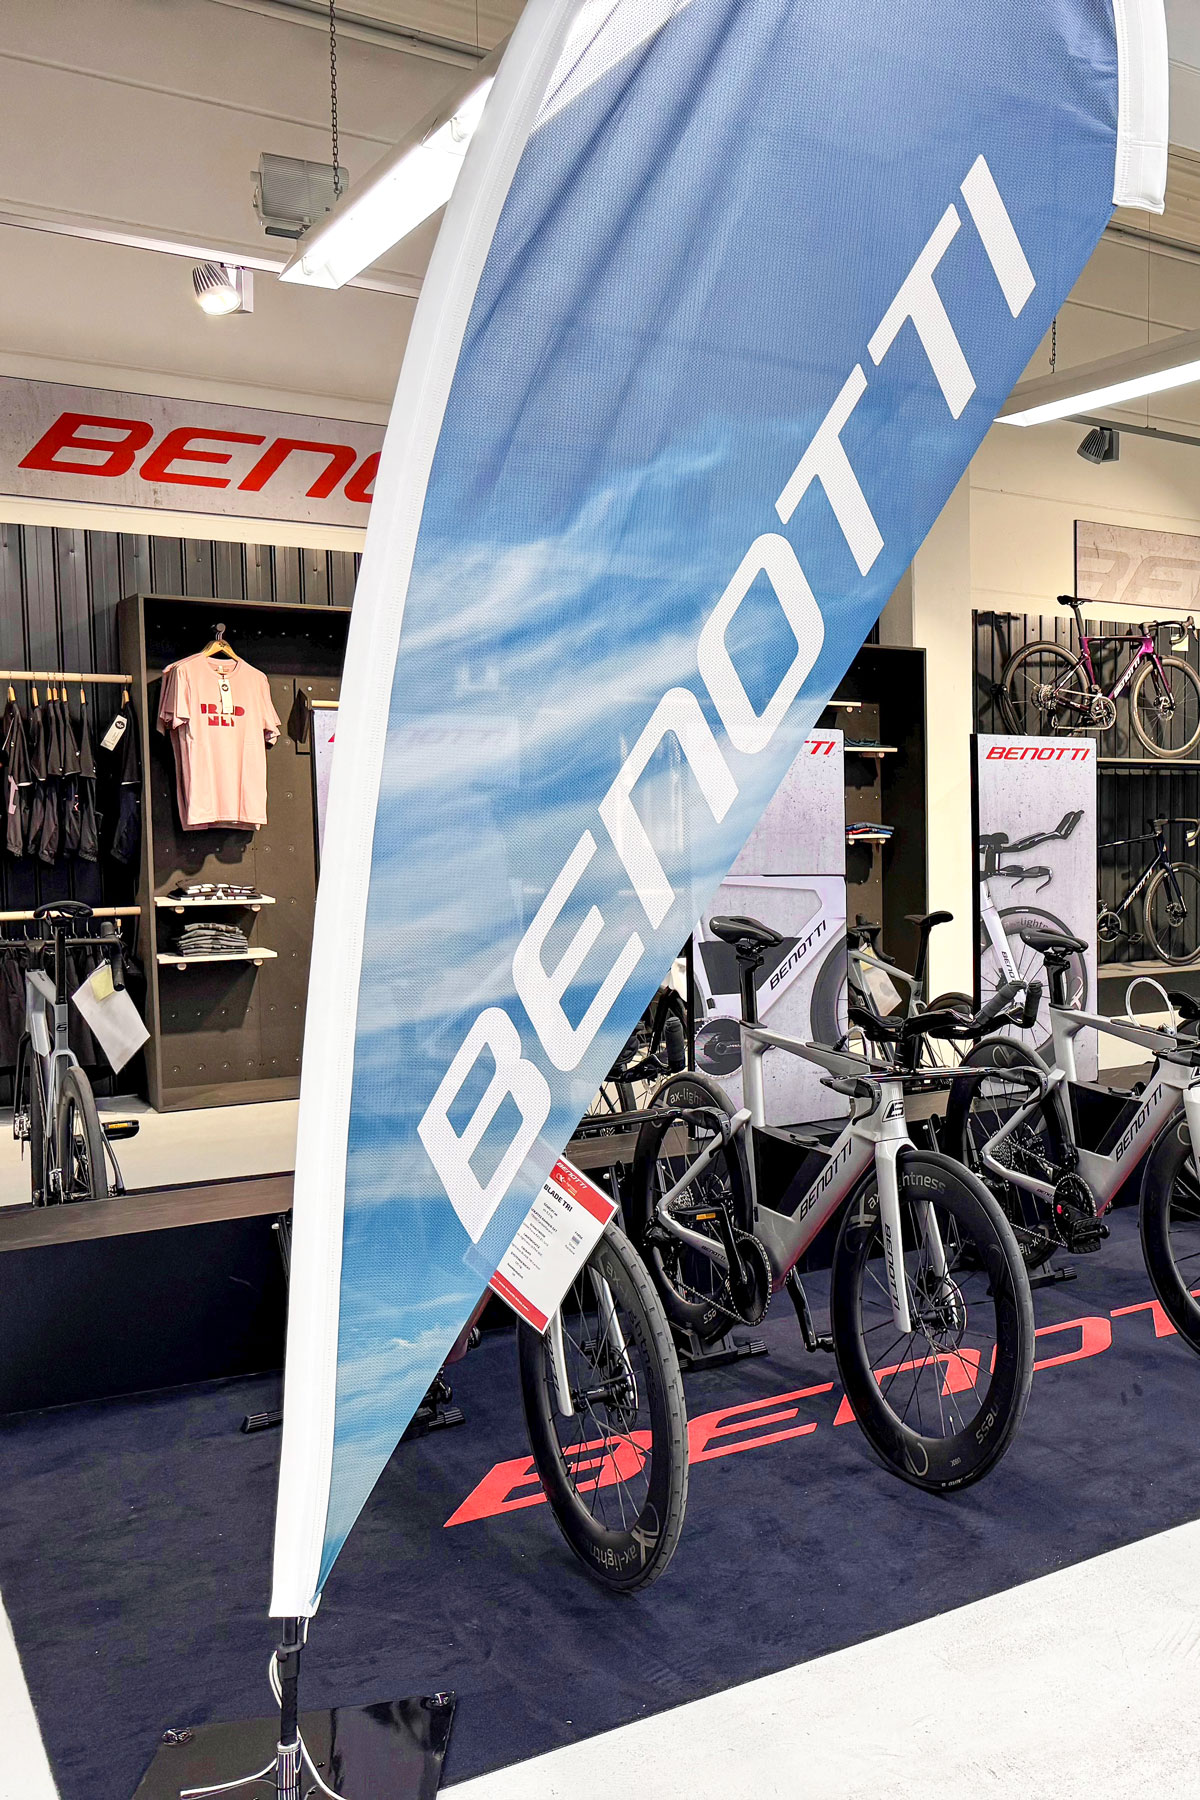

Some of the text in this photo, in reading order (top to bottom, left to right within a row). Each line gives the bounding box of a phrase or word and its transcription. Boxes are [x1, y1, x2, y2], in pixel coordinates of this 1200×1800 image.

[418, 153, 1036, 1244] BENOTTI
[986, 746, 1091, 760] BENOTTI
[770, 919, 828, 991] BENOTTI
[1114, 1084, 1162, 1162] BENOTTI
[543, 1183, 566, 1204] BLADE
[562, 1200, 574, 1213] TRI
[800, 1137, 852, 1222] BENOTTI
[884, 1223, 901, 1311] BENOTTI
